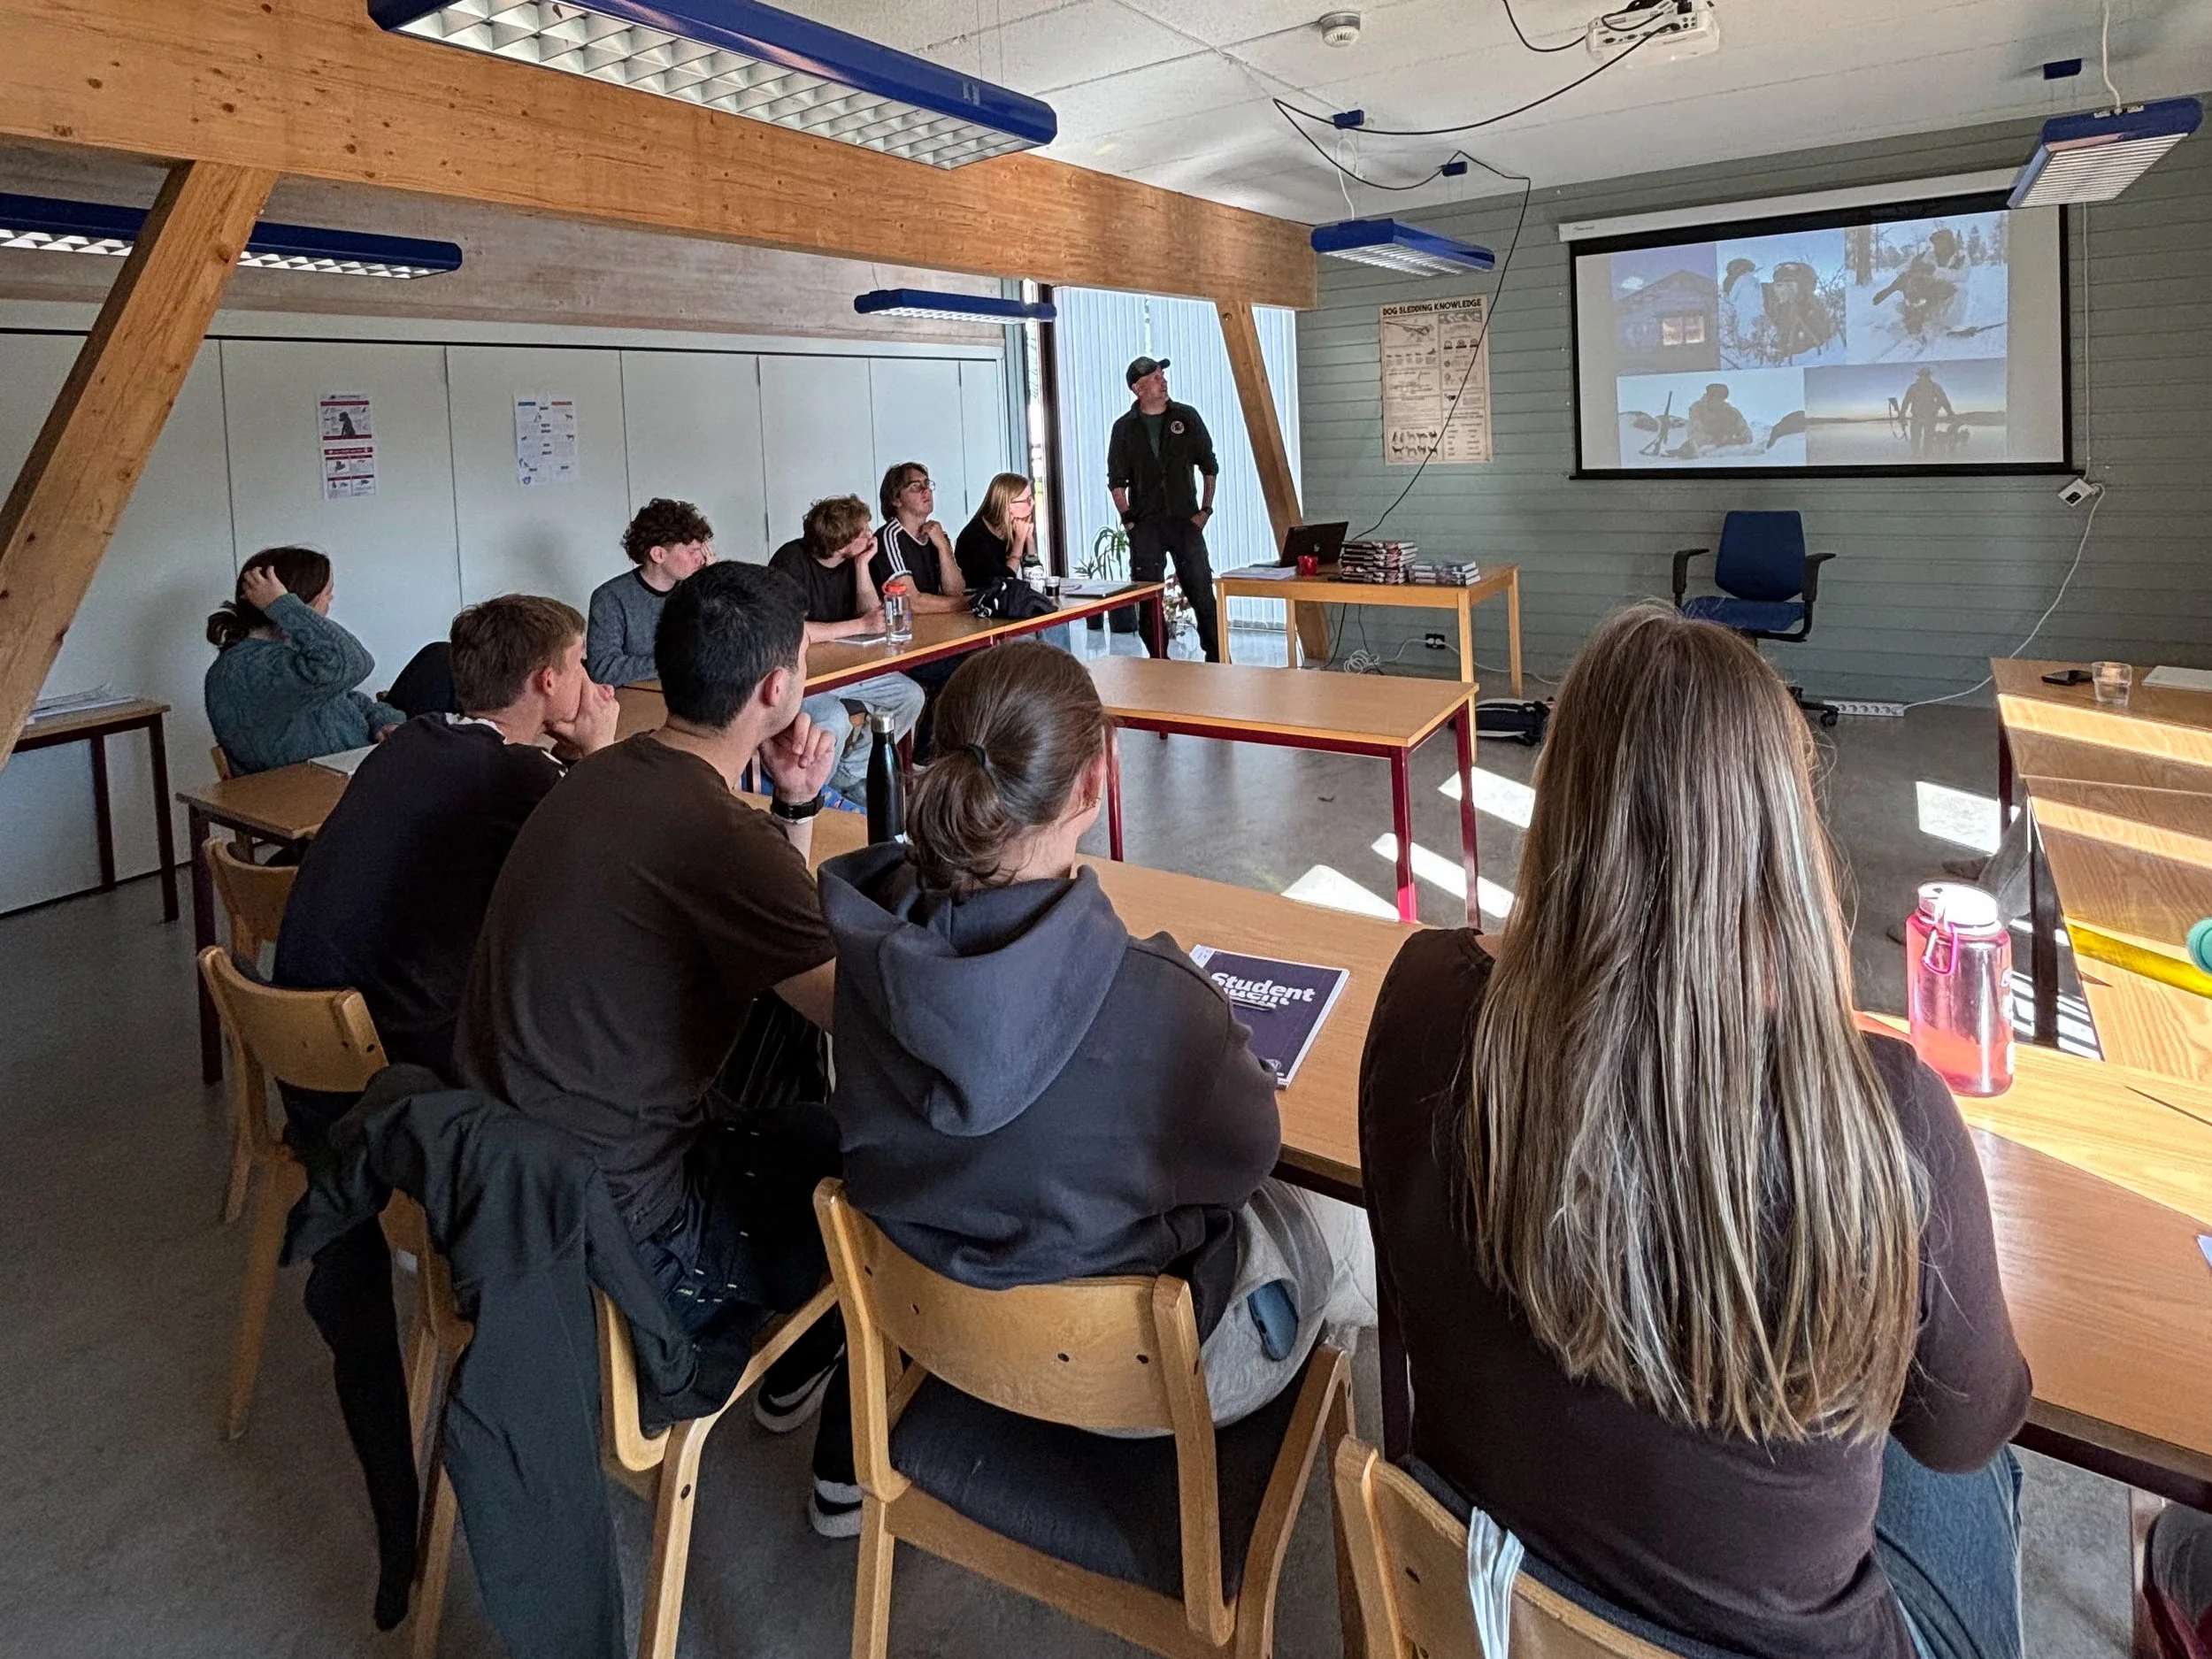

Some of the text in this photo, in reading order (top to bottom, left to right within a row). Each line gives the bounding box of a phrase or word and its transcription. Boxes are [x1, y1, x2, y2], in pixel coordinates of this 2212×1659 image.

[1383, 298, 1482, 316] DOG SLEDDING KNOWLEDGE
[1211, 972, 1316, 1002] Student
